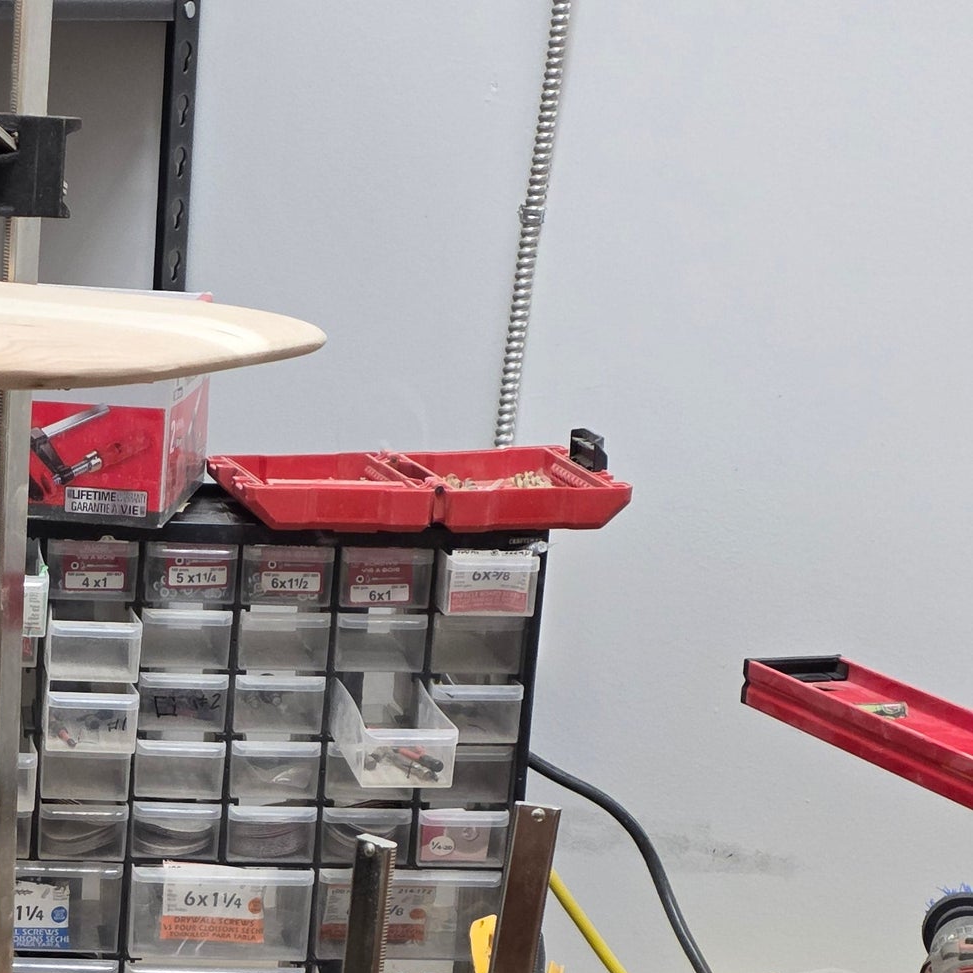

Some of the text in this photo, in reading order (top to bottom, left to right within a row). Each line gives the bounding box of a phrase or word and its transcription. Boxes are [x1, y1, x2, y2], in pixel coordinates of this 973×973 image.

[72, 490, 117, 502] LIFETIME
[71, 502, 110, 514] GARANTIE
[121, 505, 139, 516] VIE
[368, 590, 392, 601] 6x1
[173, 916, 255, 927] DRYWALL SCREWS
[22, 928, 60, 936] SCREWS
